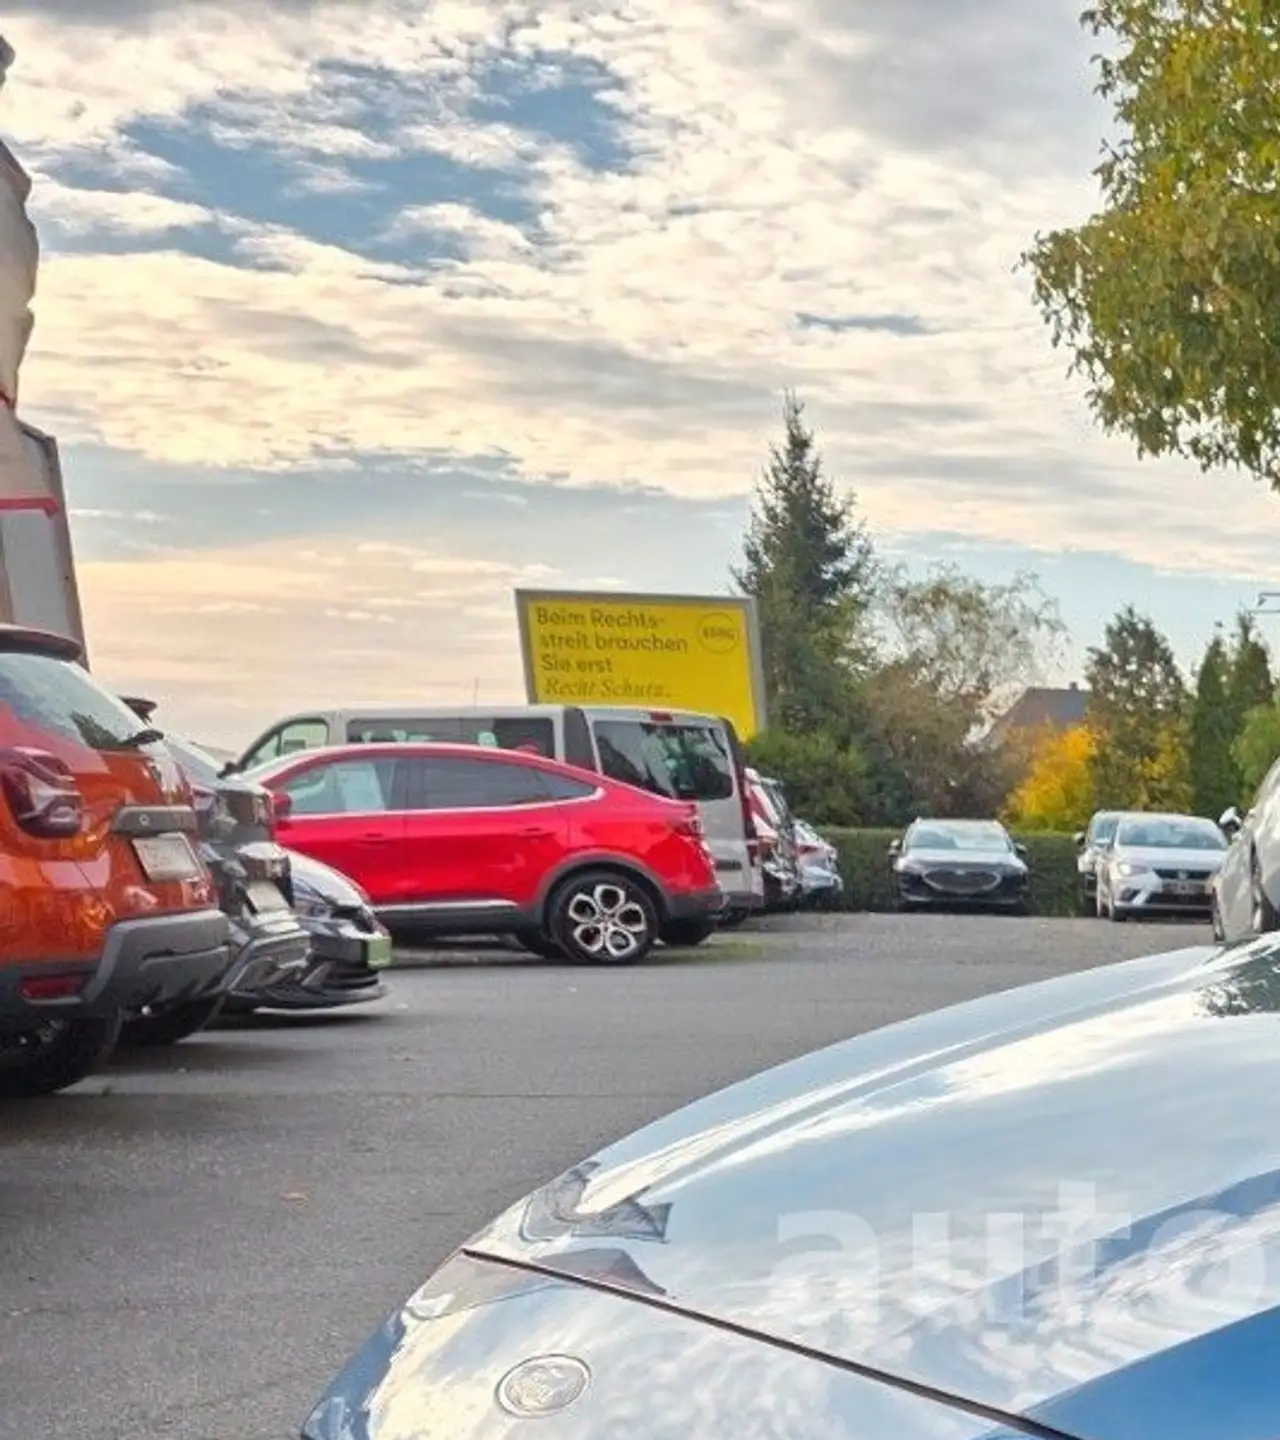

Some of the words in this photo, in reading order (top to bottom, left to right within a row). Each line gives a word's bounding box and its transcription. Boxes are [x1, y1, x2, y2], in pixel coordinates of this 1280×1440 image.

[536, 606, 585, 626] Beim
[590, 608, 666, 629] Rechts-
[541, 632, 590, 650] streit
[595, 634, 689, 653] brauchen
[540, 653, 571, 672] Sie
[576, 656, 613, 673] erst
[544, 677, 596, 697] Recht
